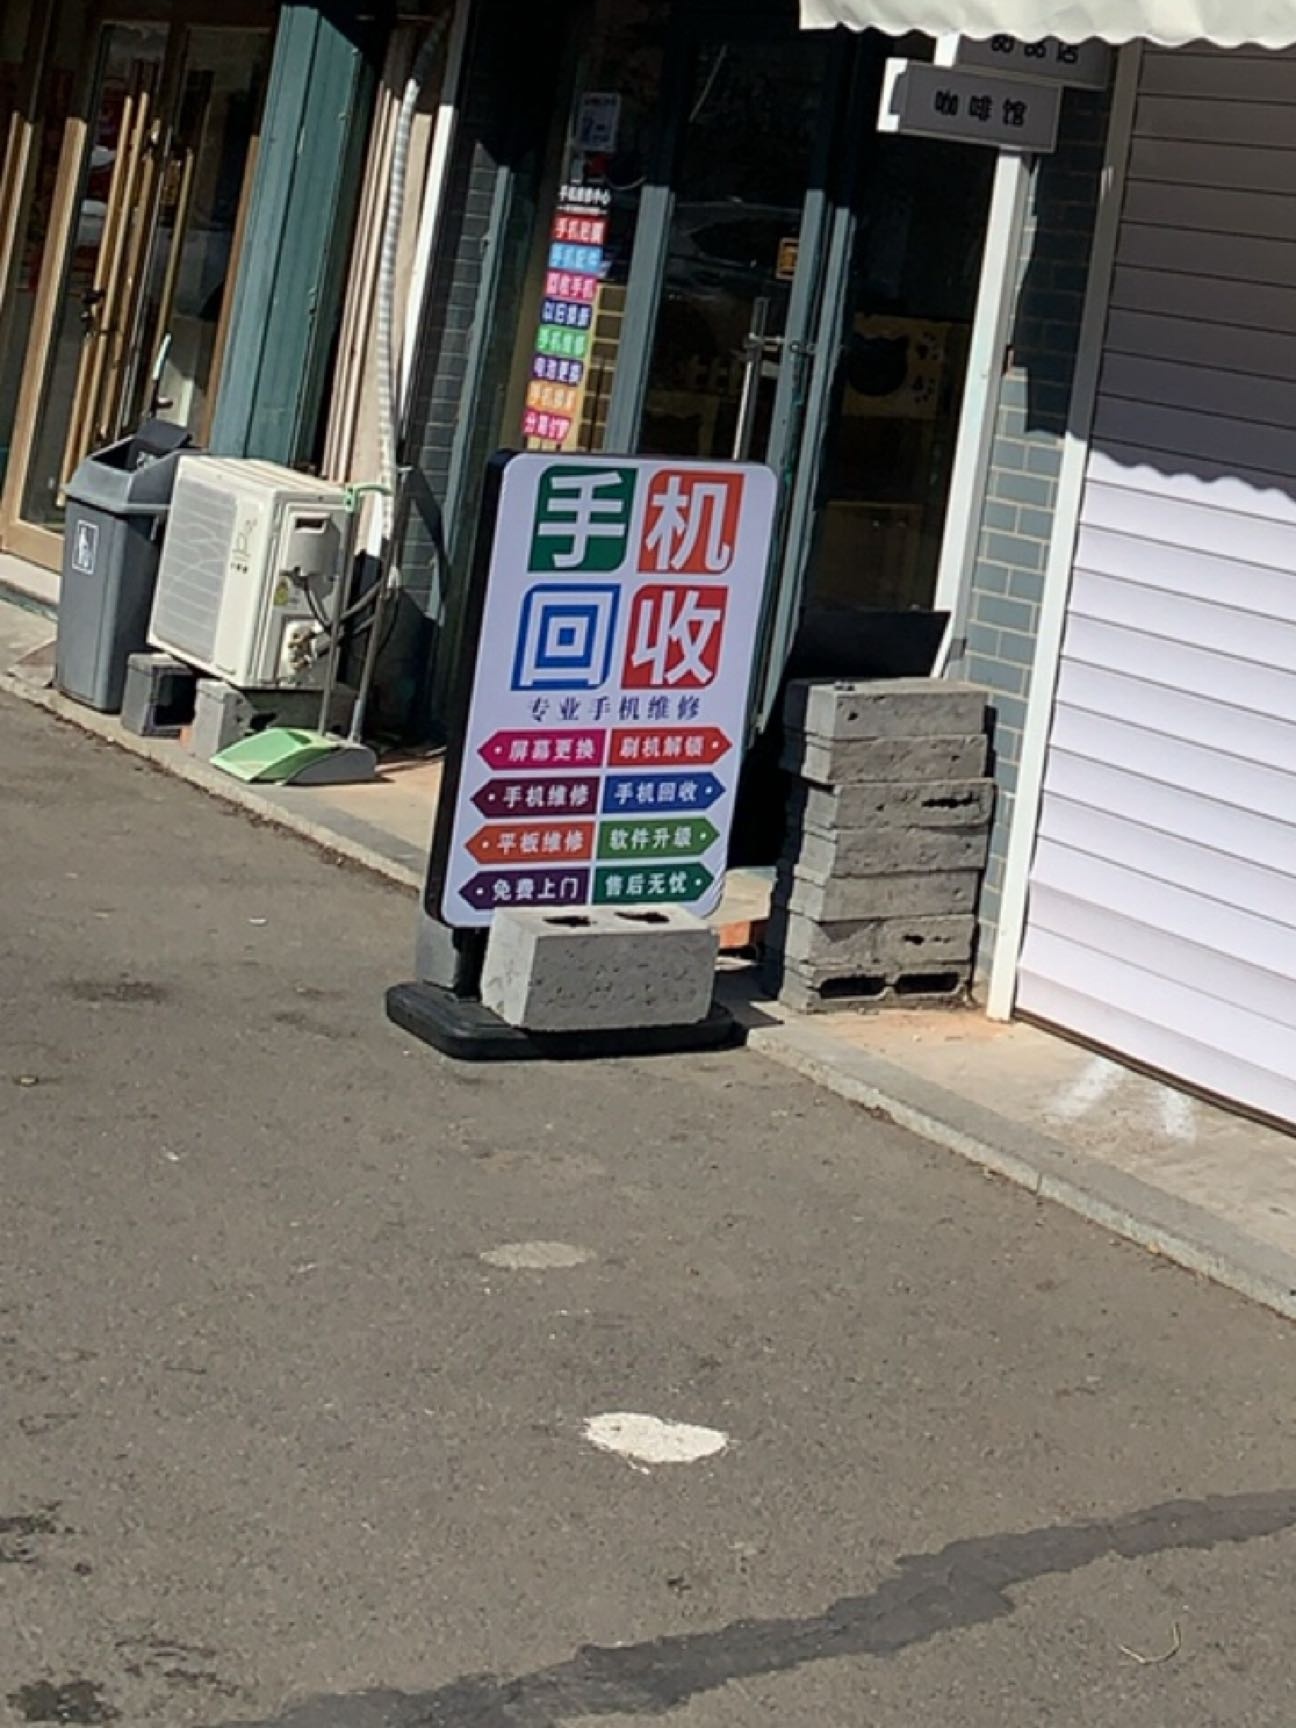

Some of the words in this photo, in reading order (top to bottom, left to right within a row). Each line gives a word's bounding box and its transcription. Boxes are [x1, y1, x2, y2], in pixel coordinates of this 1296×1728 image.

[935, 90, 1028, 127] 咖啡馆
[537, 470, 732, 572] 手机
[516, 589, 722, 688] 回收
[531, 695, 701, 722] 专业手机维修
[508, 738, 596, 762] 屏幕更换
[618, 735, 705, 759] 刷机解锁
[503, 784, 590, 808] 手机维修
[614, 781, 699, 805] 手机回收
[497, 831, 584, 855] 平板维修
[609, 827, 693, 850] 软件升级
[492, 877, 579, 901] 免费上门
[605, 872, 687, 896] 售后无忧
